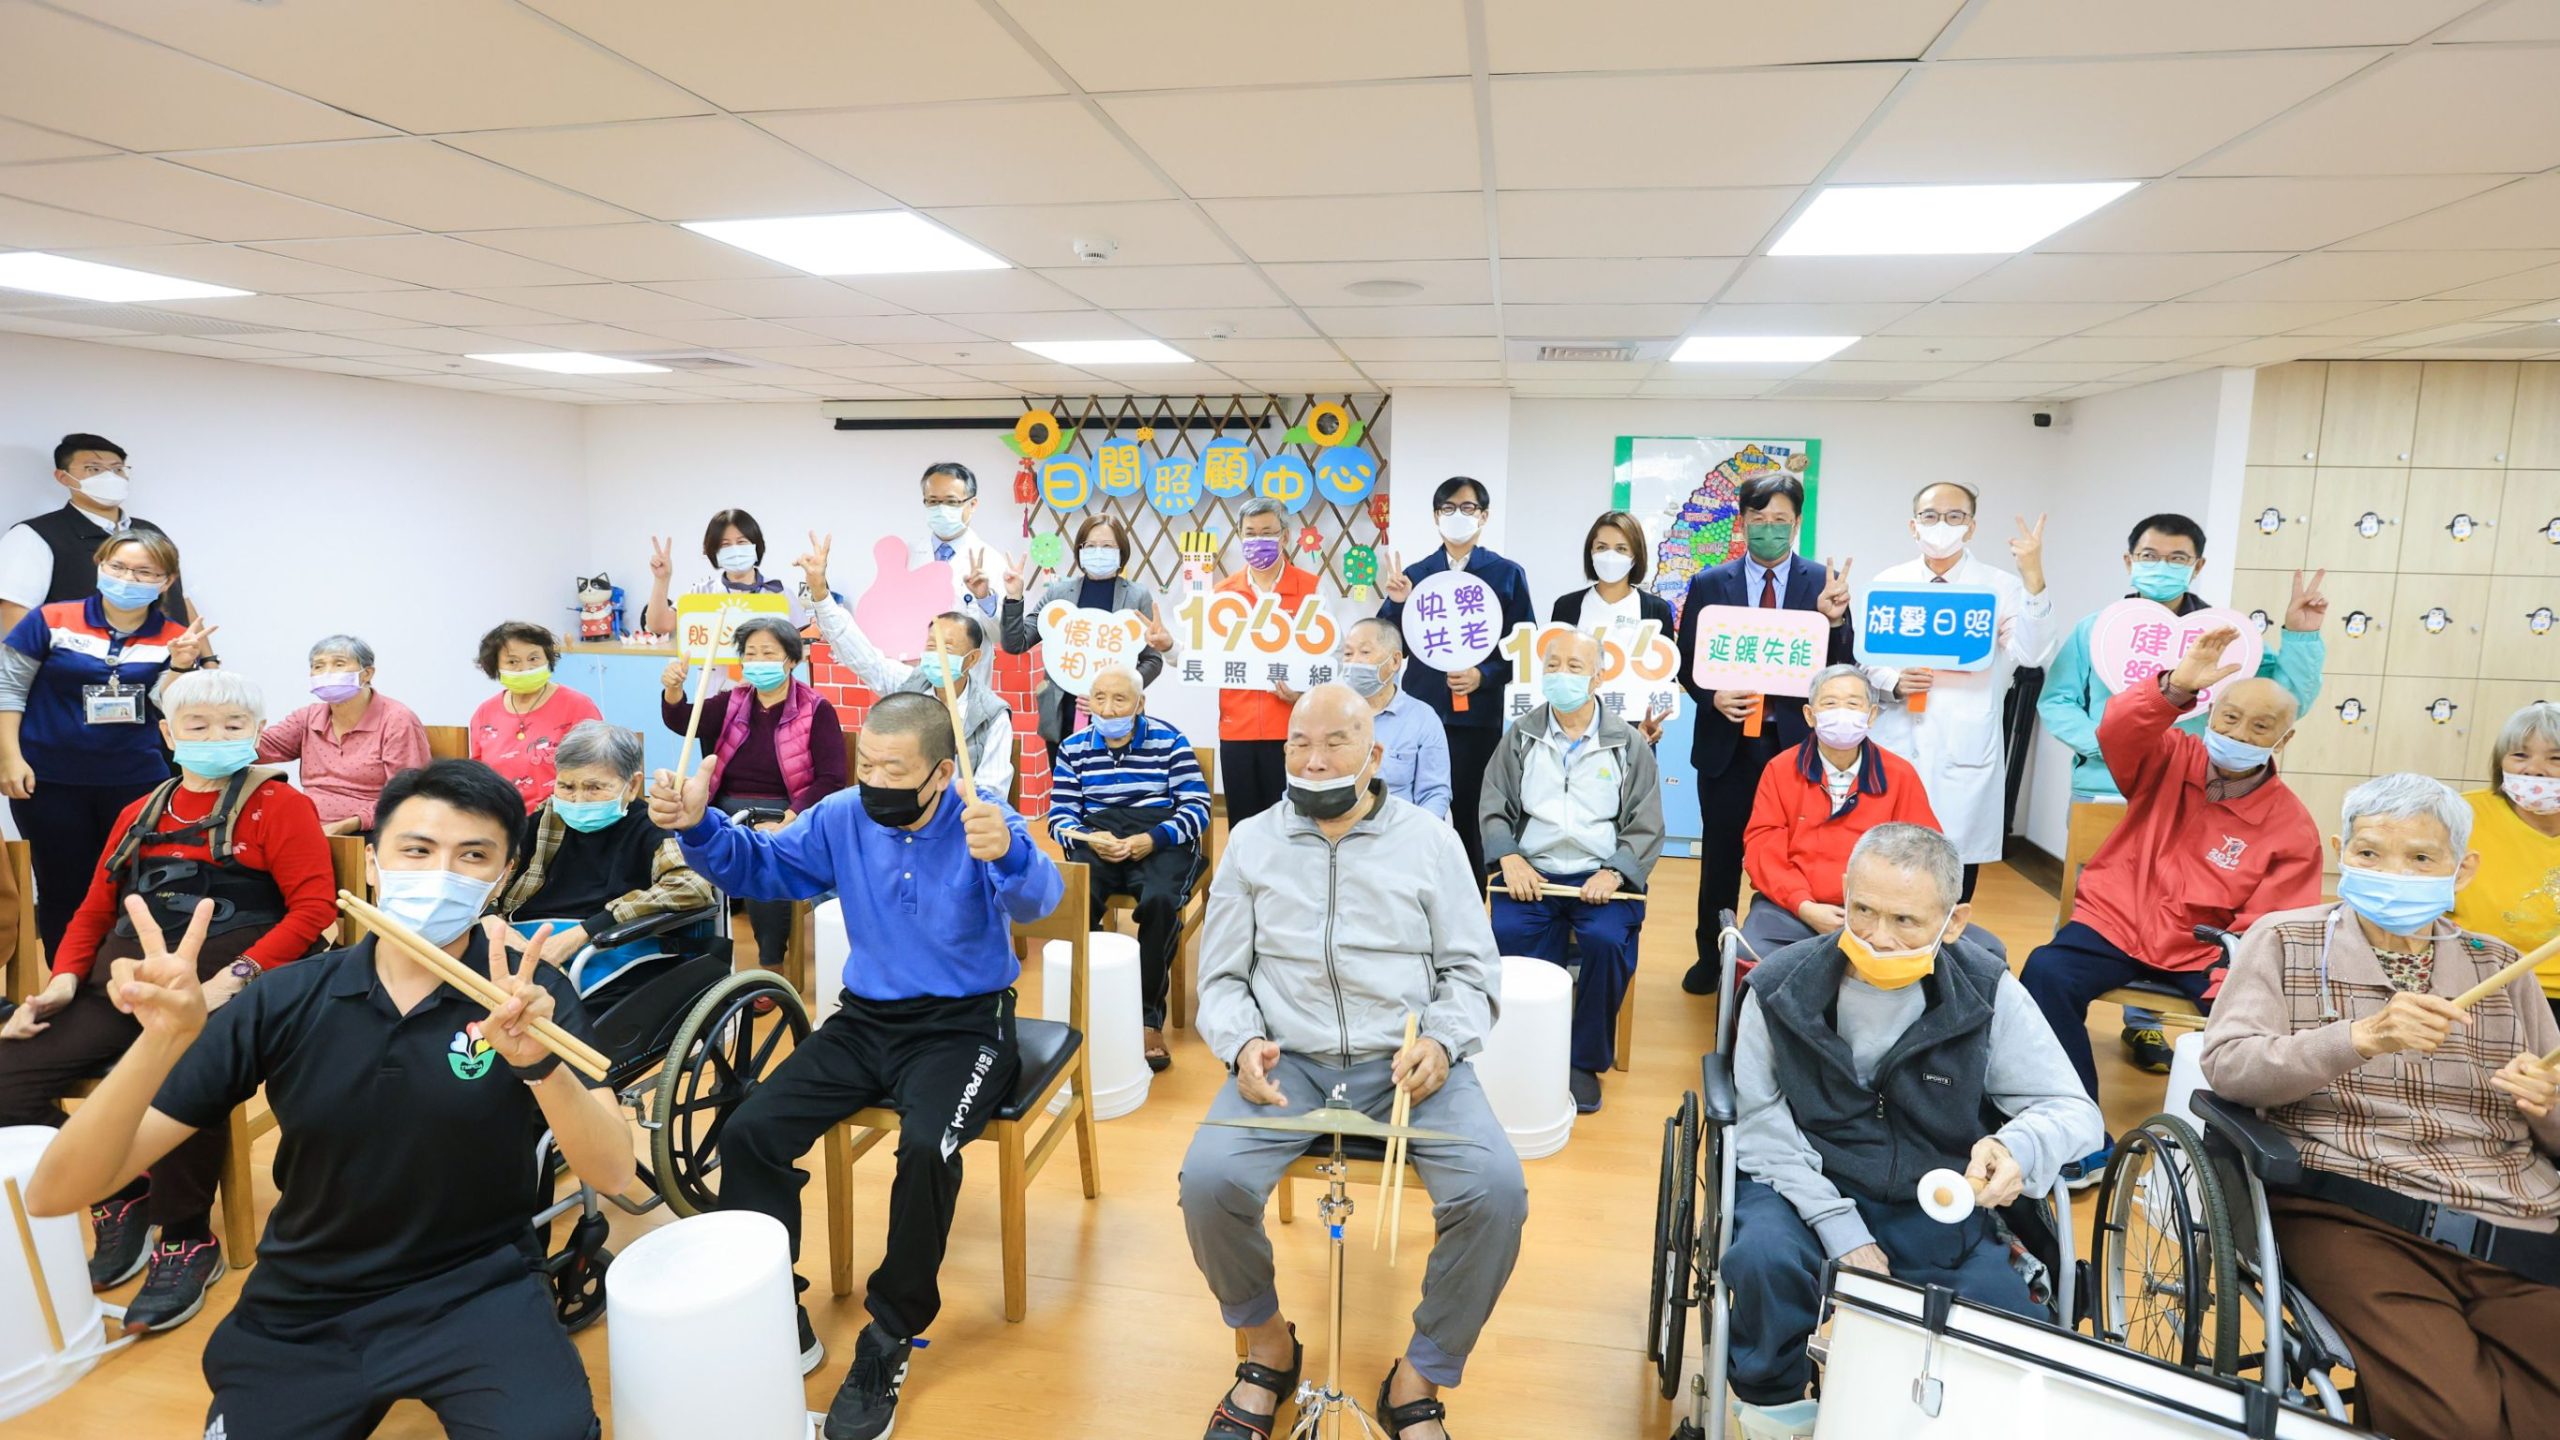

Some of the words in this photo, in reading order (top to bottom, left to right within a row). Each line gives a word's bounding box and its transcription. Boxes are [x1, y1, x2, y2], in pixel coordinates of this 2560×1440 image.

[1043, 445, 1371, 509] 日間照顧中心
[1416, 585, 1485, 621] 快樂
[1064, 619, 1123, 652] 憶路
[1179, 596, 1335, 655] 1966
[1422, 620, 1490, 658] 共老
[1868, 604, 1992, 640] 旗醫日照
[1707, 634, 1814, 668] 延緩失能
[1182, 660, 1338, 687] 長照專線
[1510, 691, 1674, 716] 長專線
